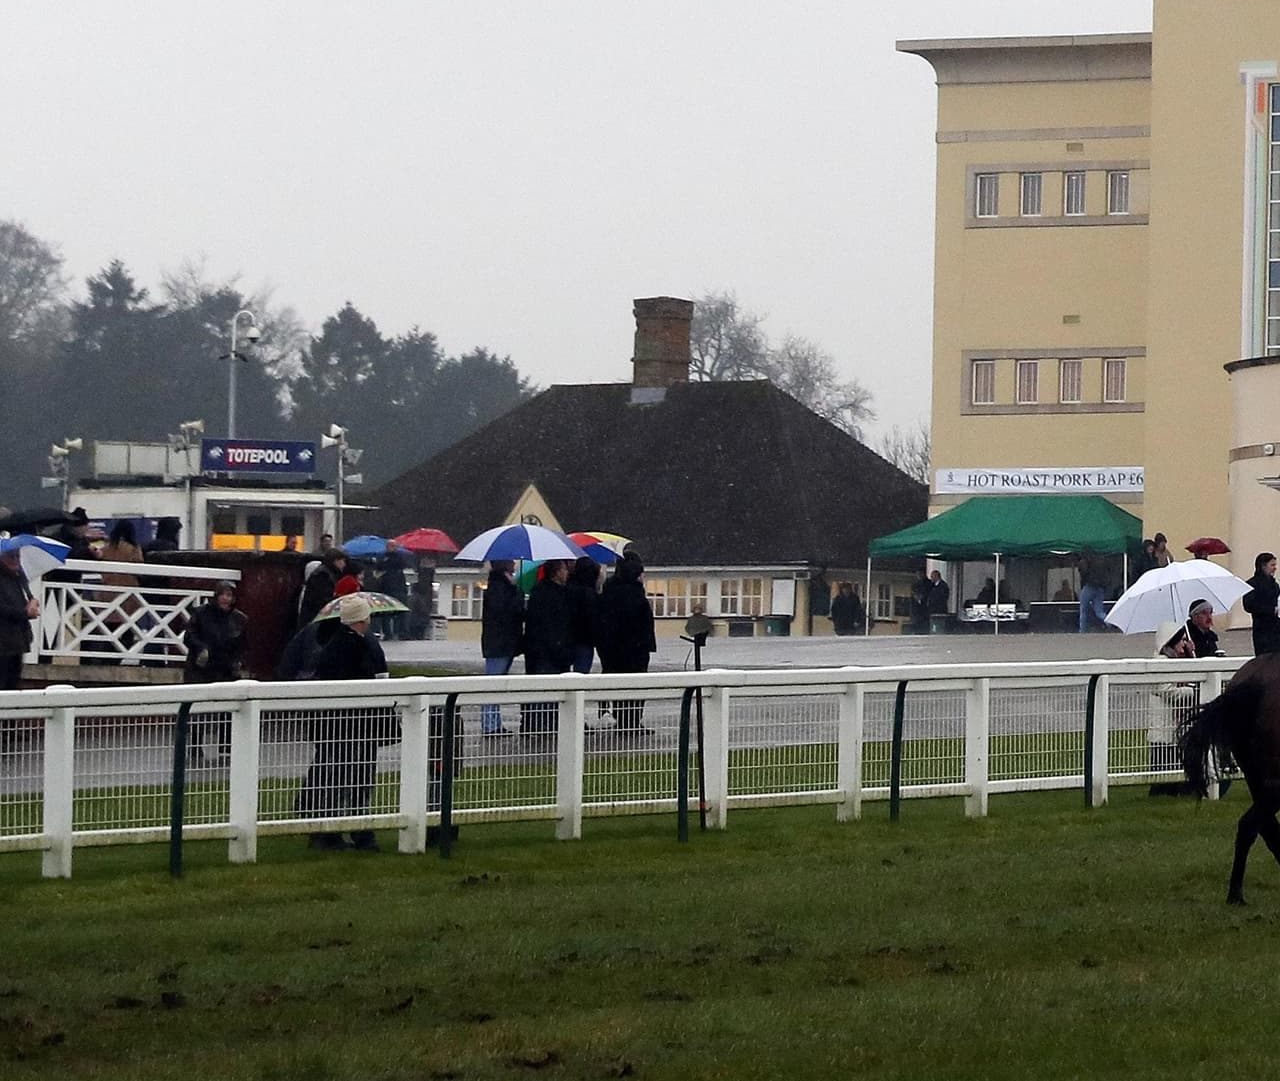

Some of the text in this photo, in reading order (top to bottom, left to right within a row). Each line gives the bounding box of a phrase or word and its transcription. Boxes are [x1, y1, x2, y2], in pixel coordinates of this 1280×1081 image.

[227, 448, 290, 464] TOTEPOOL
[967, 474, 998, 487] HOT
[1001, 473, 1049, 487] ROAST
[1053, 473, 1093, 486] PORK
[1097, 473, 1126, 486] BAP
